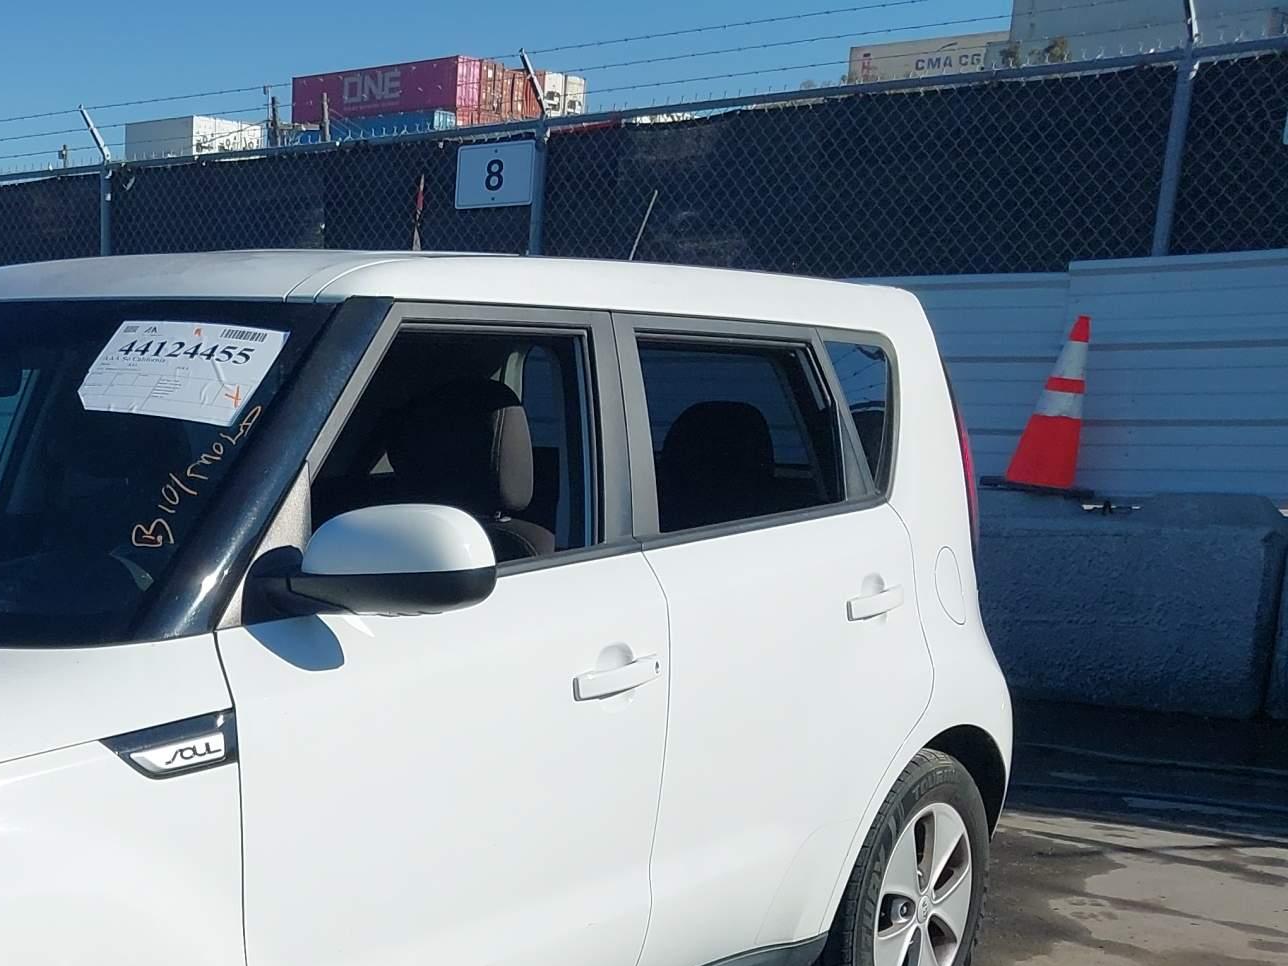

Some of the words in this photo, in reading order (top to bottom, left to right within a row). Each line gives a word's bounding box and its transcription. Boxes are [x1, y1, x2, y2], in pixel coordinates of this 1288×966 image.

[914, 55, 953, 71] CMA
[958, 53, 982, 67] CG
[342, 70, 402, 105] ONE
[484, 158, 505, 191] 8
[118, 338, 256, 365] 44124455
[164, 742, 223, 765] SOUL
